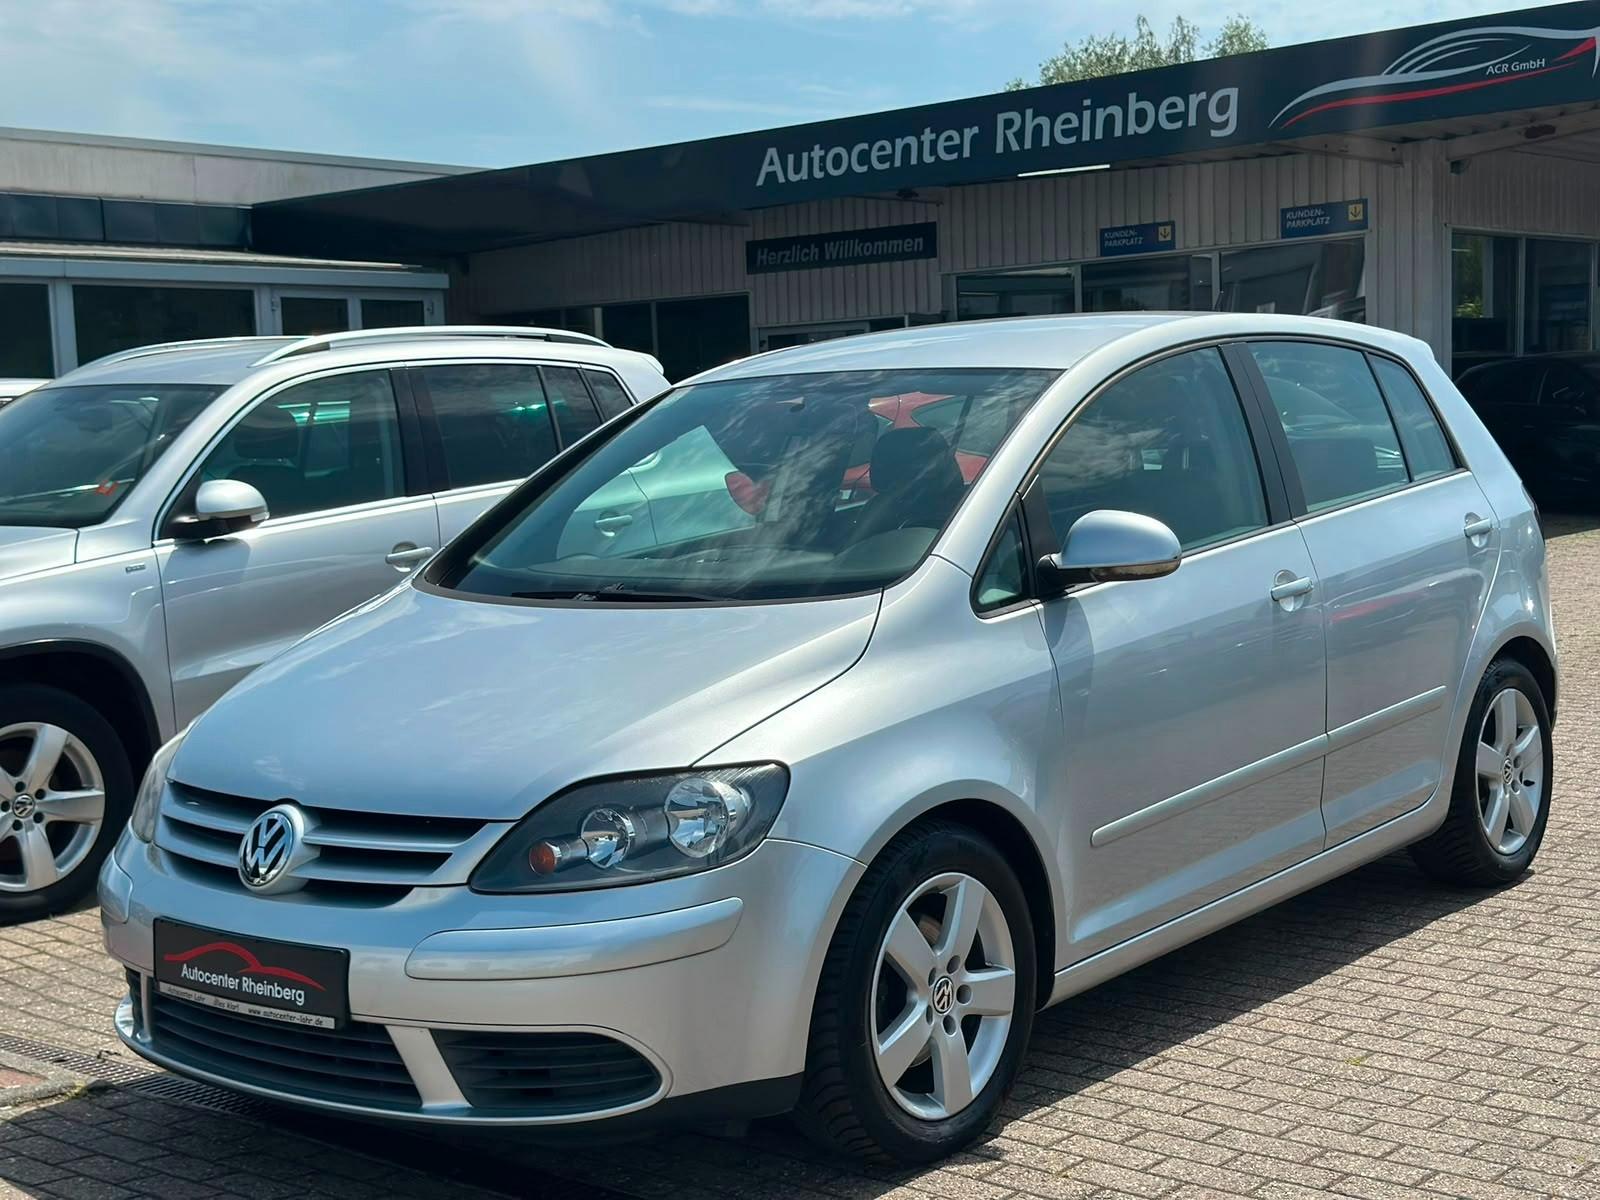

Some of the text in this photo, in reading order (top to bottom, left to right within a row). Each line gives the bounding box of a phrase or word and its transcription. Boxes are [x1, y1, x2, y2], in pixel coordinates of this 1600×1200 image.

[1486, 58, 1546, 76] ACR GmbH
[756, 87, 1240, 187] Autocenter Rheinberg
[1286, 217, 1331, 229] PARKPLATZ
[756, 237, 924, 266] Herzlich Willkommen
[181, 963, 239, 990] Autocenter
[242, 976, 305, 1006] Rheinberg
